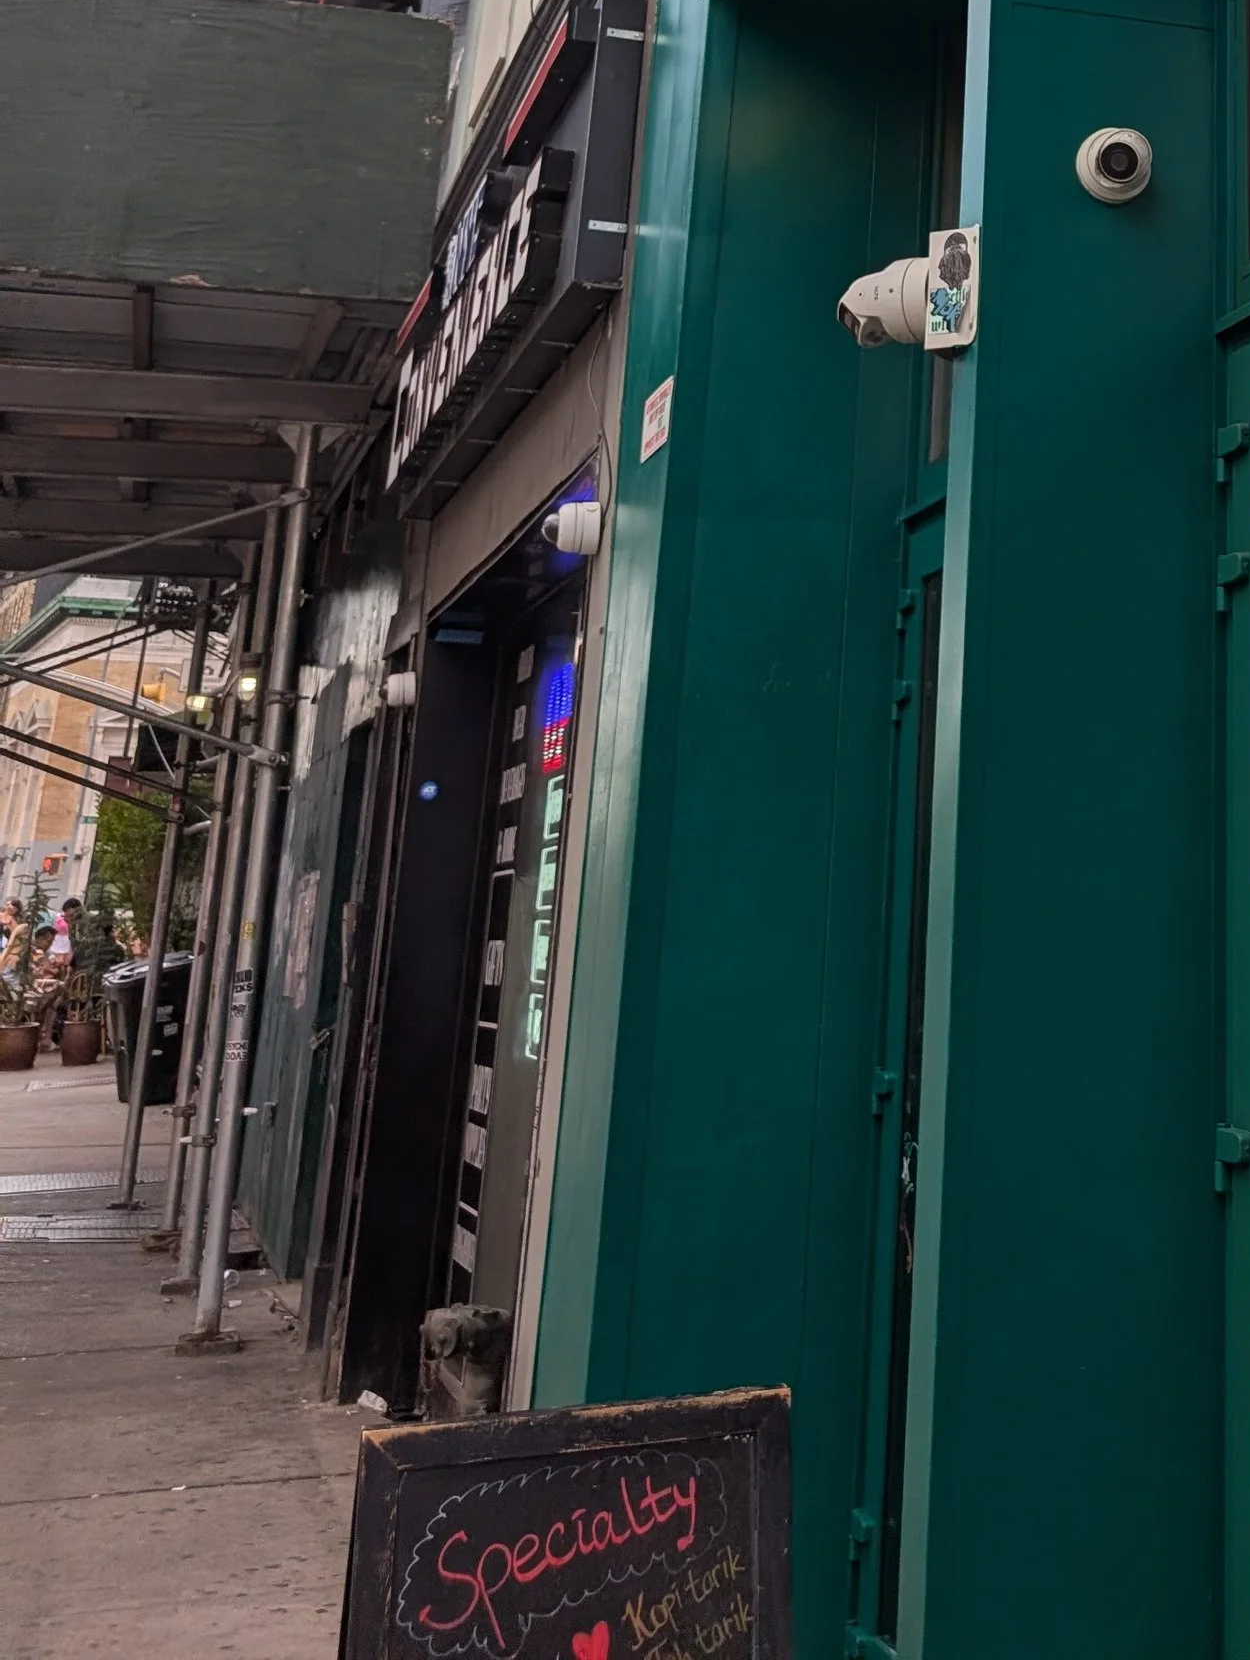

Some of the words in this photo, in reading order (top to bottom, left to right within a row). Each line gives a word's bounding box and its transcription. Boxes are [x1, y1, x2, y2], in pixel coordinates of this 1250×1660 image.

[385, 152, 544, 491] CONVENIENCE
[419, 1475, 697, 1649] Specialty
[621, 1582, 683, 1651] Kopi
[685, 1545, 746, 1602] tarik
[694, 1592, 755, 1654] tarik
